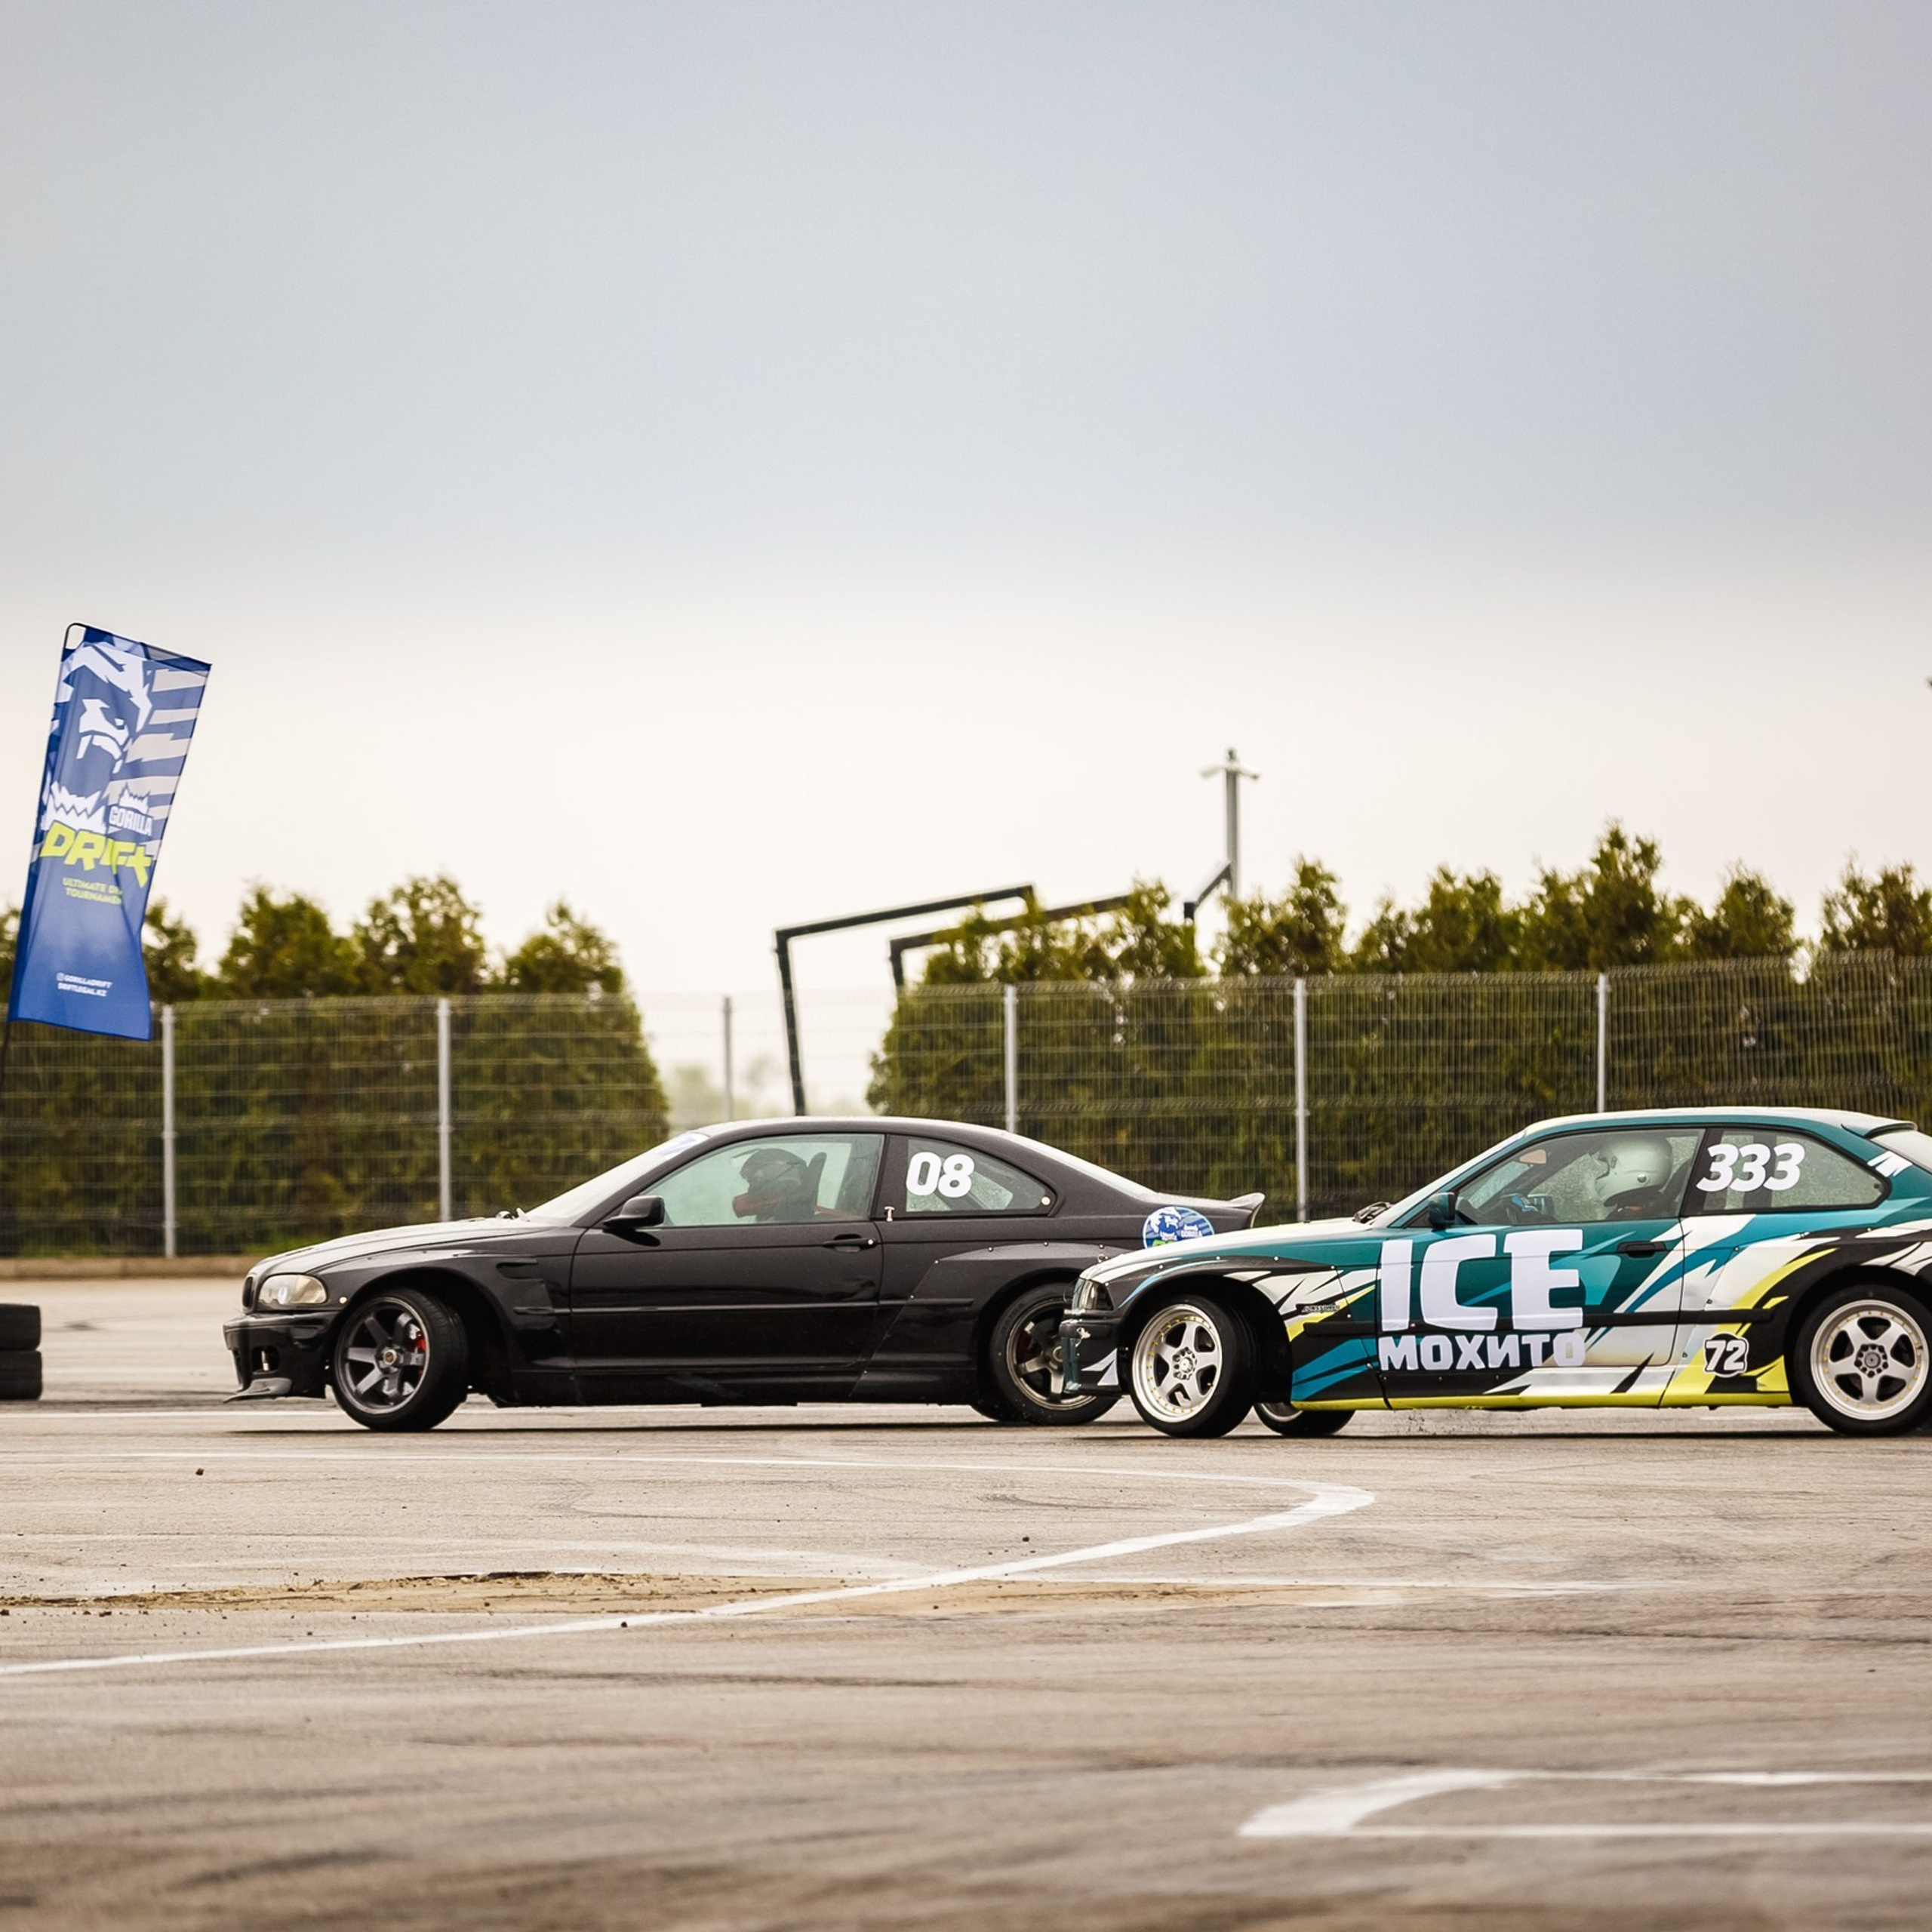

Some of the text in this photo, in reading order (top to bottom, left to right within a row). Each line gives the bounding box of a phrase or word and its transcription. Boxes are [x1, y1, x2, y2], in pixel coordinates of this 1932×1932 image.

[109, 805, 152, 836] GORILLA
[63, 878, 107, 892] ULTIMATE
[906, 1152, 974, 1198] 08
[1696, 1143, 1805, 1192] 333
[1380, 1229, 1583, 1331] ICE
[1378, 1332, 1586, 1371] МОХИТО
[1706, 1340, 1746, 1371] 72
